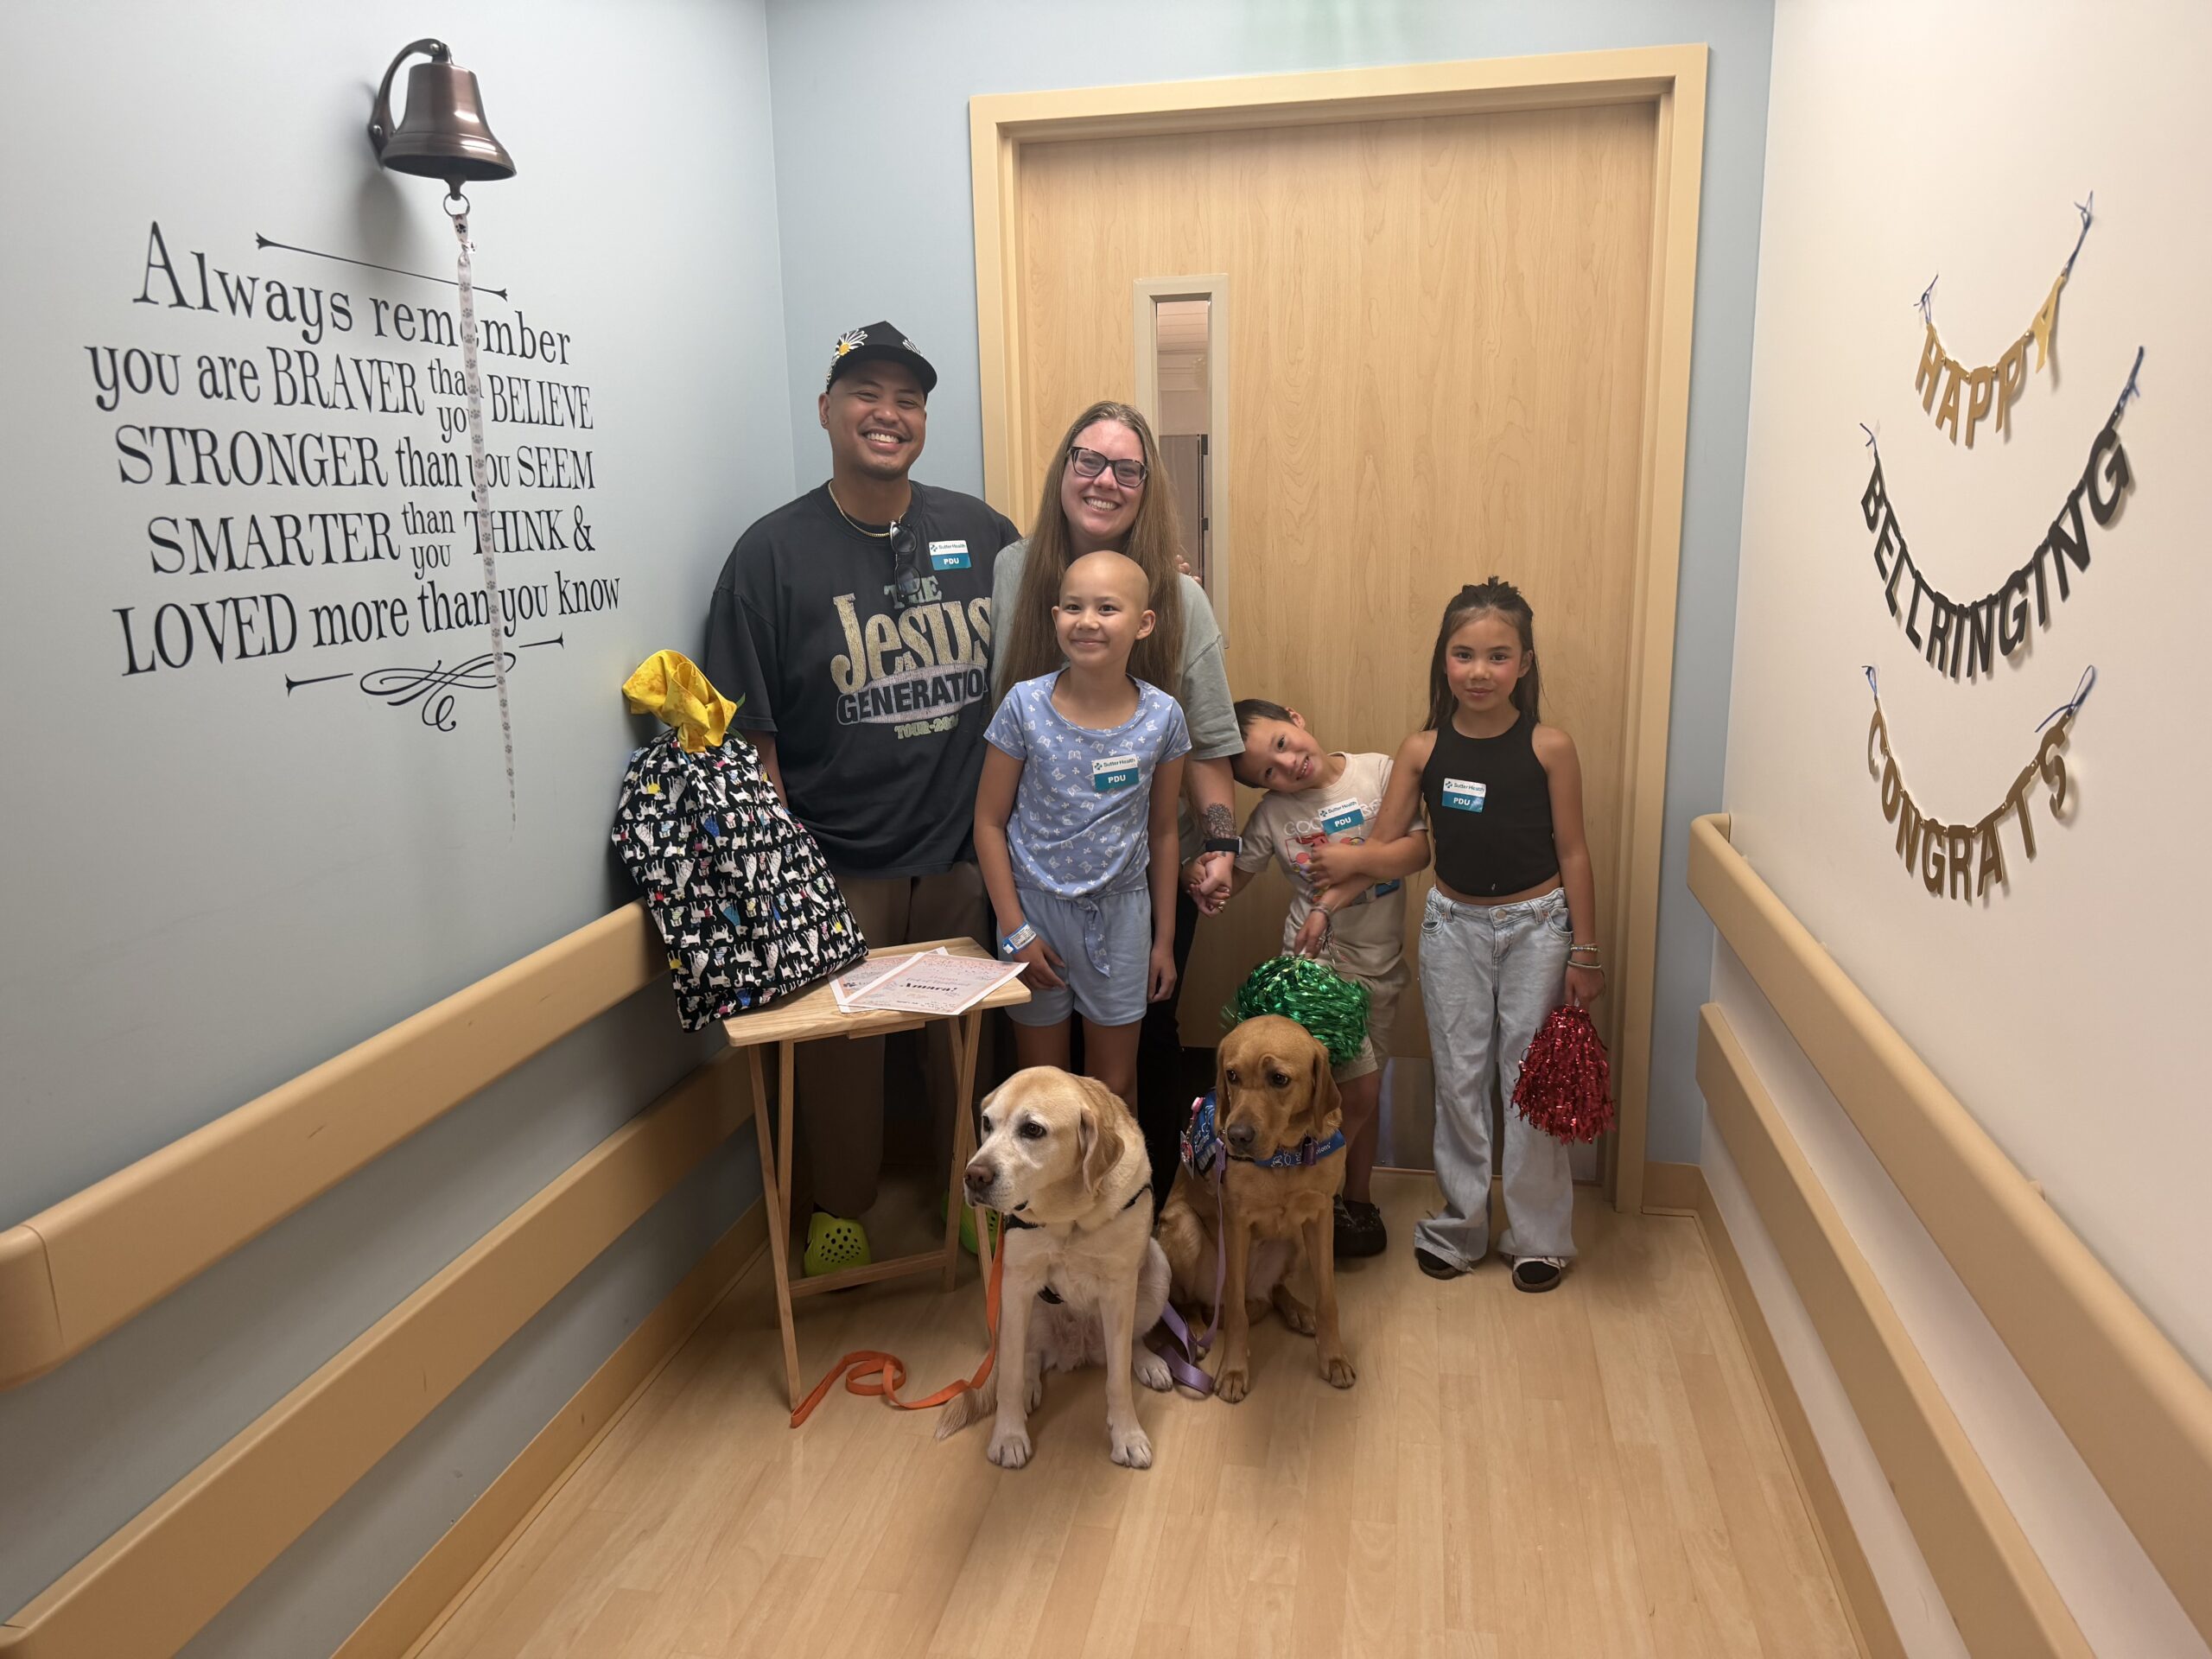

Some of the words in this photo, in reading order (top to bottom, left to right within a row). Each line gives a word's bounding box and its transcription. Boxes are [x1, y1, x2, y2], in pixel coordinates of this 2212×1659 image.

[133, 221, 353, 344] Always
[84, 346, 181, 411] you
[197, 354, 260, 404] are
[267, 346, 424, 416] BRAVER
[428, 358, 484, 398] tha
[1915, 273, 2067, 448] HAPPY
[436, 407, 471, 443] yo
[486, 374, 594, 429] BELIEVE
[115, 424, 388, 487] STRONGER
[395, 435, 463, 487] than
[517, 446, 595, 490] SEEM
[148, 513, 401, 575] SMARTER
[401, 501, 456, 535] than
[464, 510, 569, 555] THINK
[573, 505, 595, 552] &
[410, 543, 451, 580] you
[112, 593, 297, 677] LOVED
[309, 599, 409, 651] more
[417, 581, 491, 633] than
[499, 586, 549, 638] you
[555, 570, 620, 616] know
[837, 669, 987, 723] GENERATIO
[1108, 774, 1126, 784] PDU
[1453, 797, 1471, 806] PDU
[1867, 709, 2066, 900] CONGRATS
[1334, 817, 1352, 828] PDU
